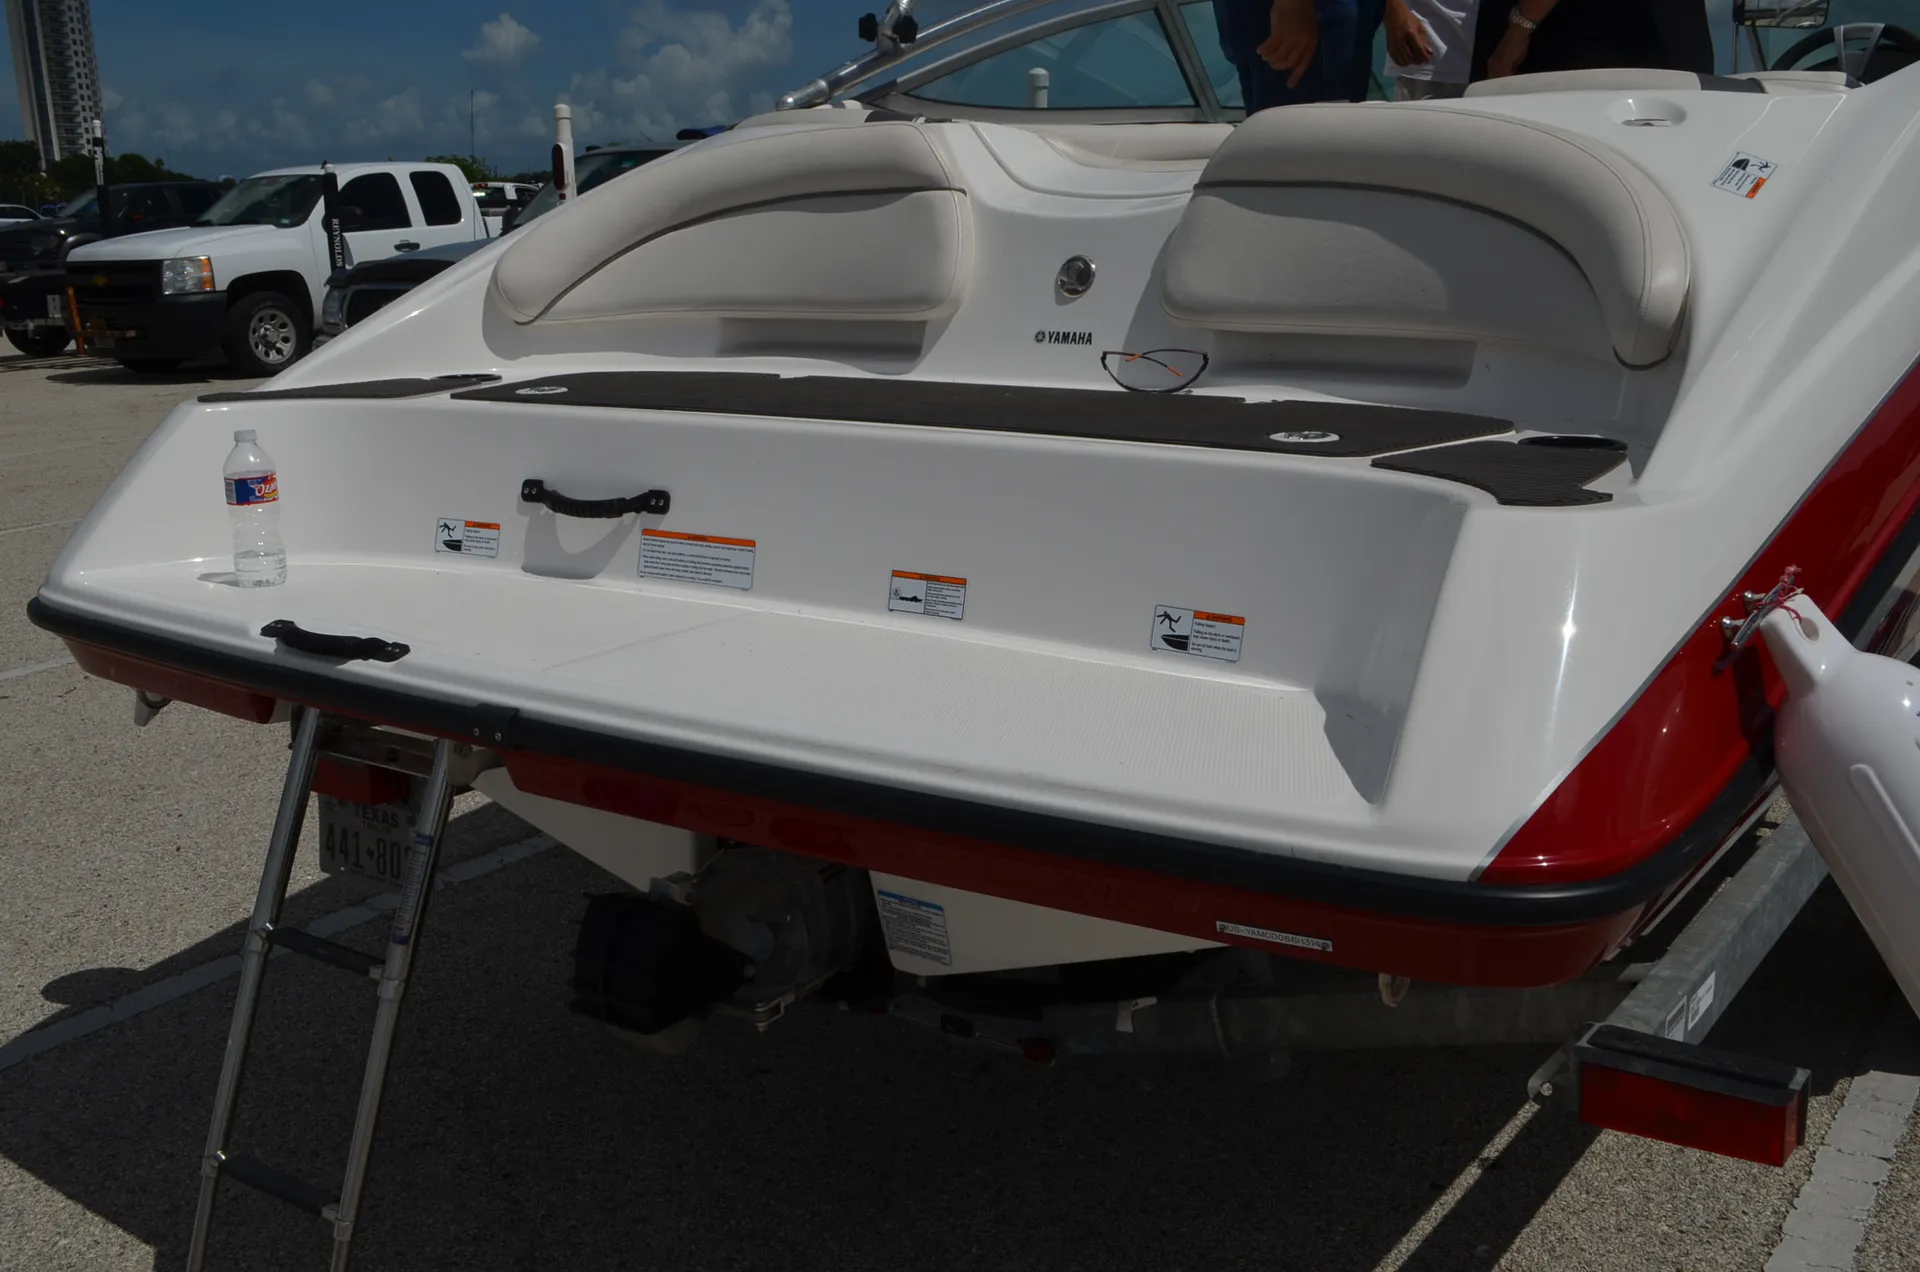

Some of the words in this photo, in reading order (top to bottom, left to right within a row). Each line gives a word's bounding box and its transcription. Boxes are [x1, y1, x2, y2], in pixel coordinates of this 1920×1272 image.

[331, 218, 344, 267] REYNOLDS
[1048, 331, 1092, 345] YAMAHA
[355, 805, 399, 828] TEXAS
